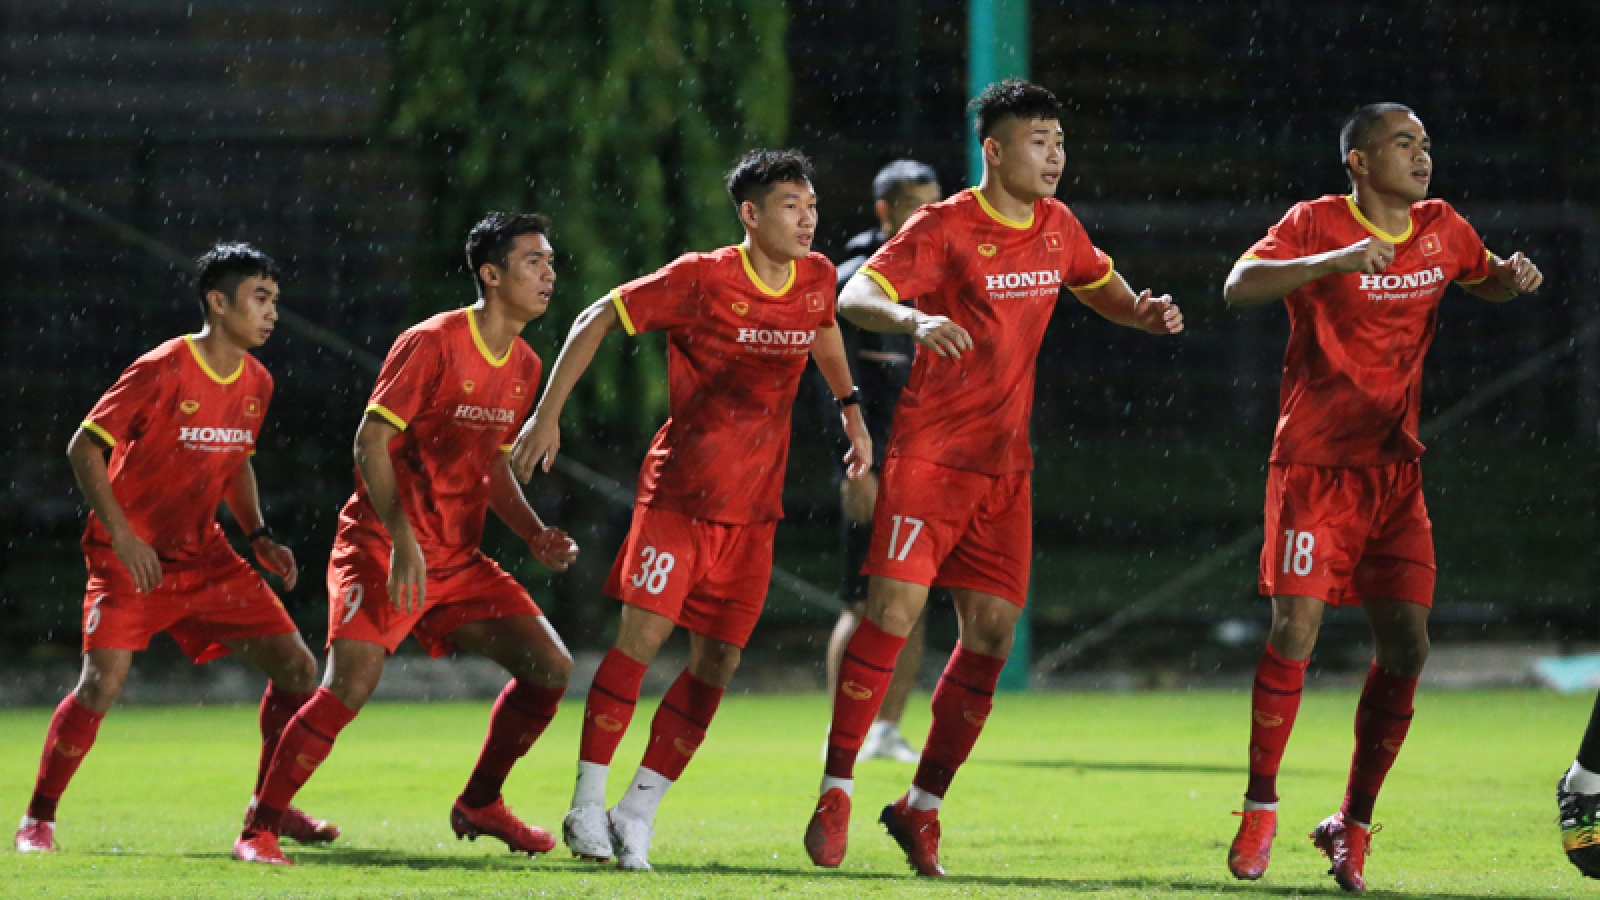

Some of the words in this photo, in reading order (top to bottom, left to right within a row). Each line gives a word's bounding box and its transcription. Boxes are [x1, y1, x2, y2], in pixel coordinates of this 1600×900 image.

[985, 269, 1062, 290] HONDA
[1358, 266, 1444, 290] HONDA
[989, 291, 1004, 300] The
[1005, 290, 1028, 298] Power
[454, 404, 514, 423] HONDA
[177, 426, 254, 445] HONDA
[887, 514, 924, 562] 17
[1282, 528, 1315, 576] 18
[632, 545, 676, 595] 38
[86, 593, 104, 634] 6
[342, 583, 364, 625] 9
